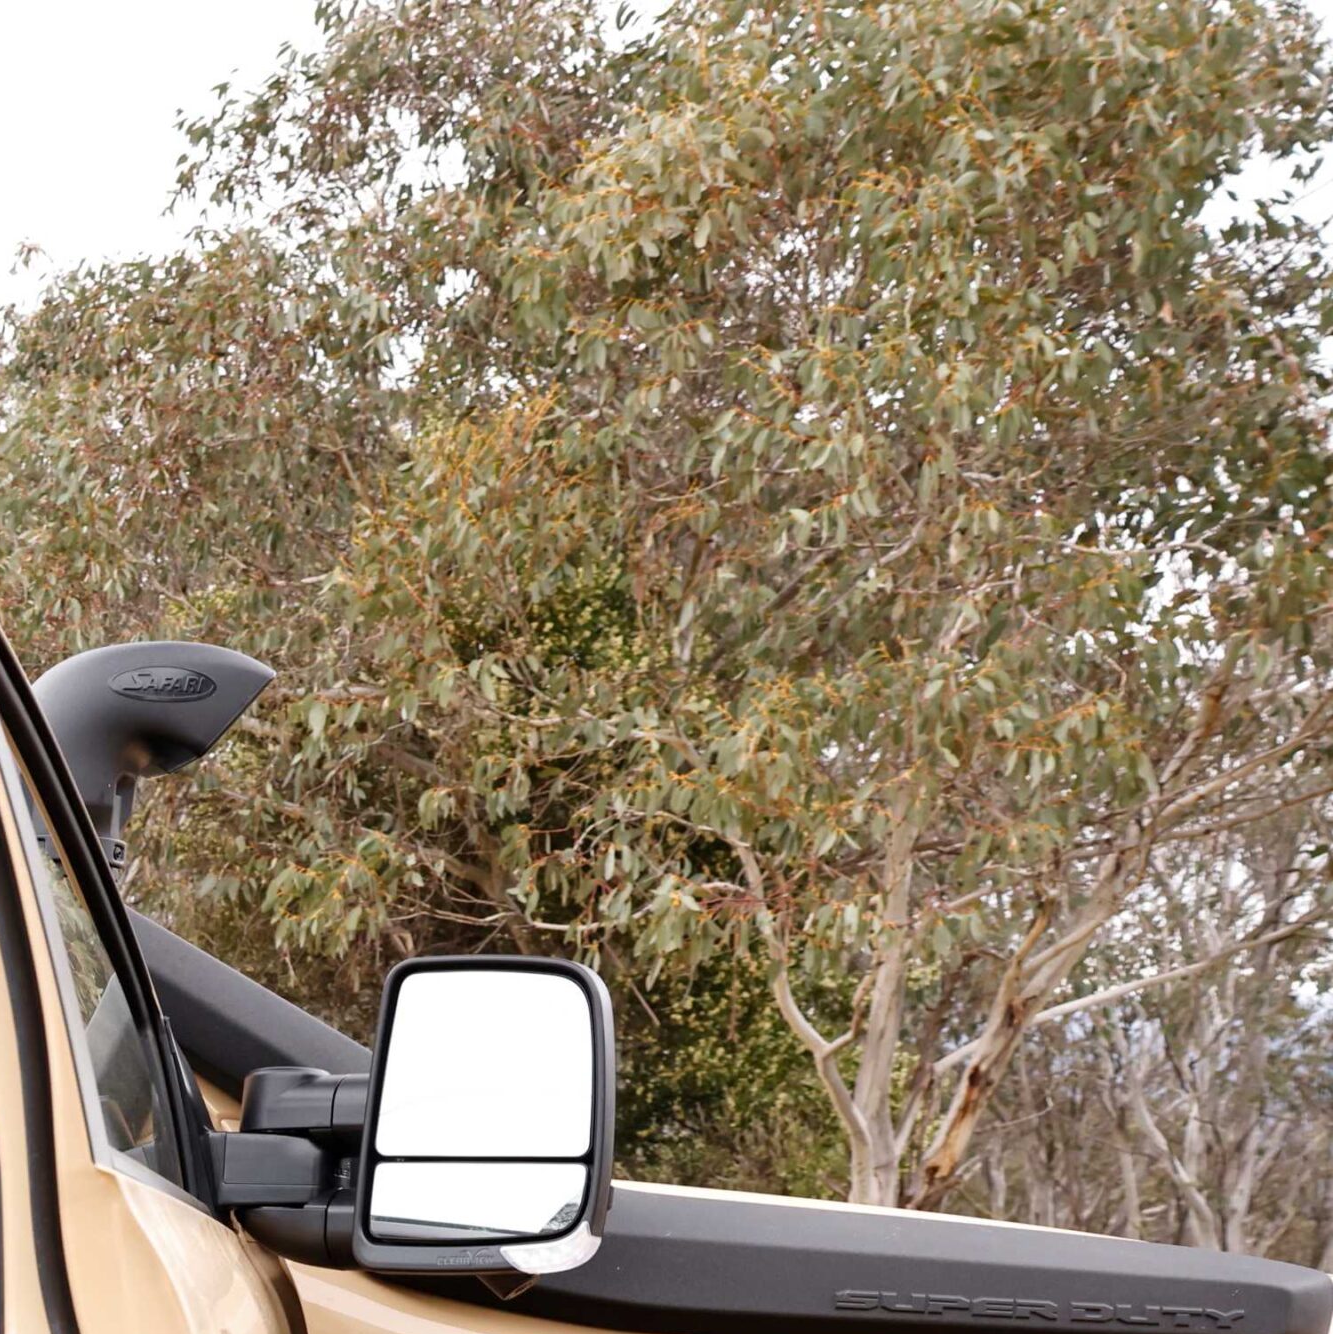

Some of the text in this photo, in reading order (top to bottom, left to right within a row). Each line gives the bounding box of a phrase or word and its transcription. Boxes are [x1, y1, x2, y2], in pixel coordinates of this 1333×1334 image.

[122, 671, 205, 695] SAFARI
[836, 1289, 1245, 1329] SUPER DUTY
